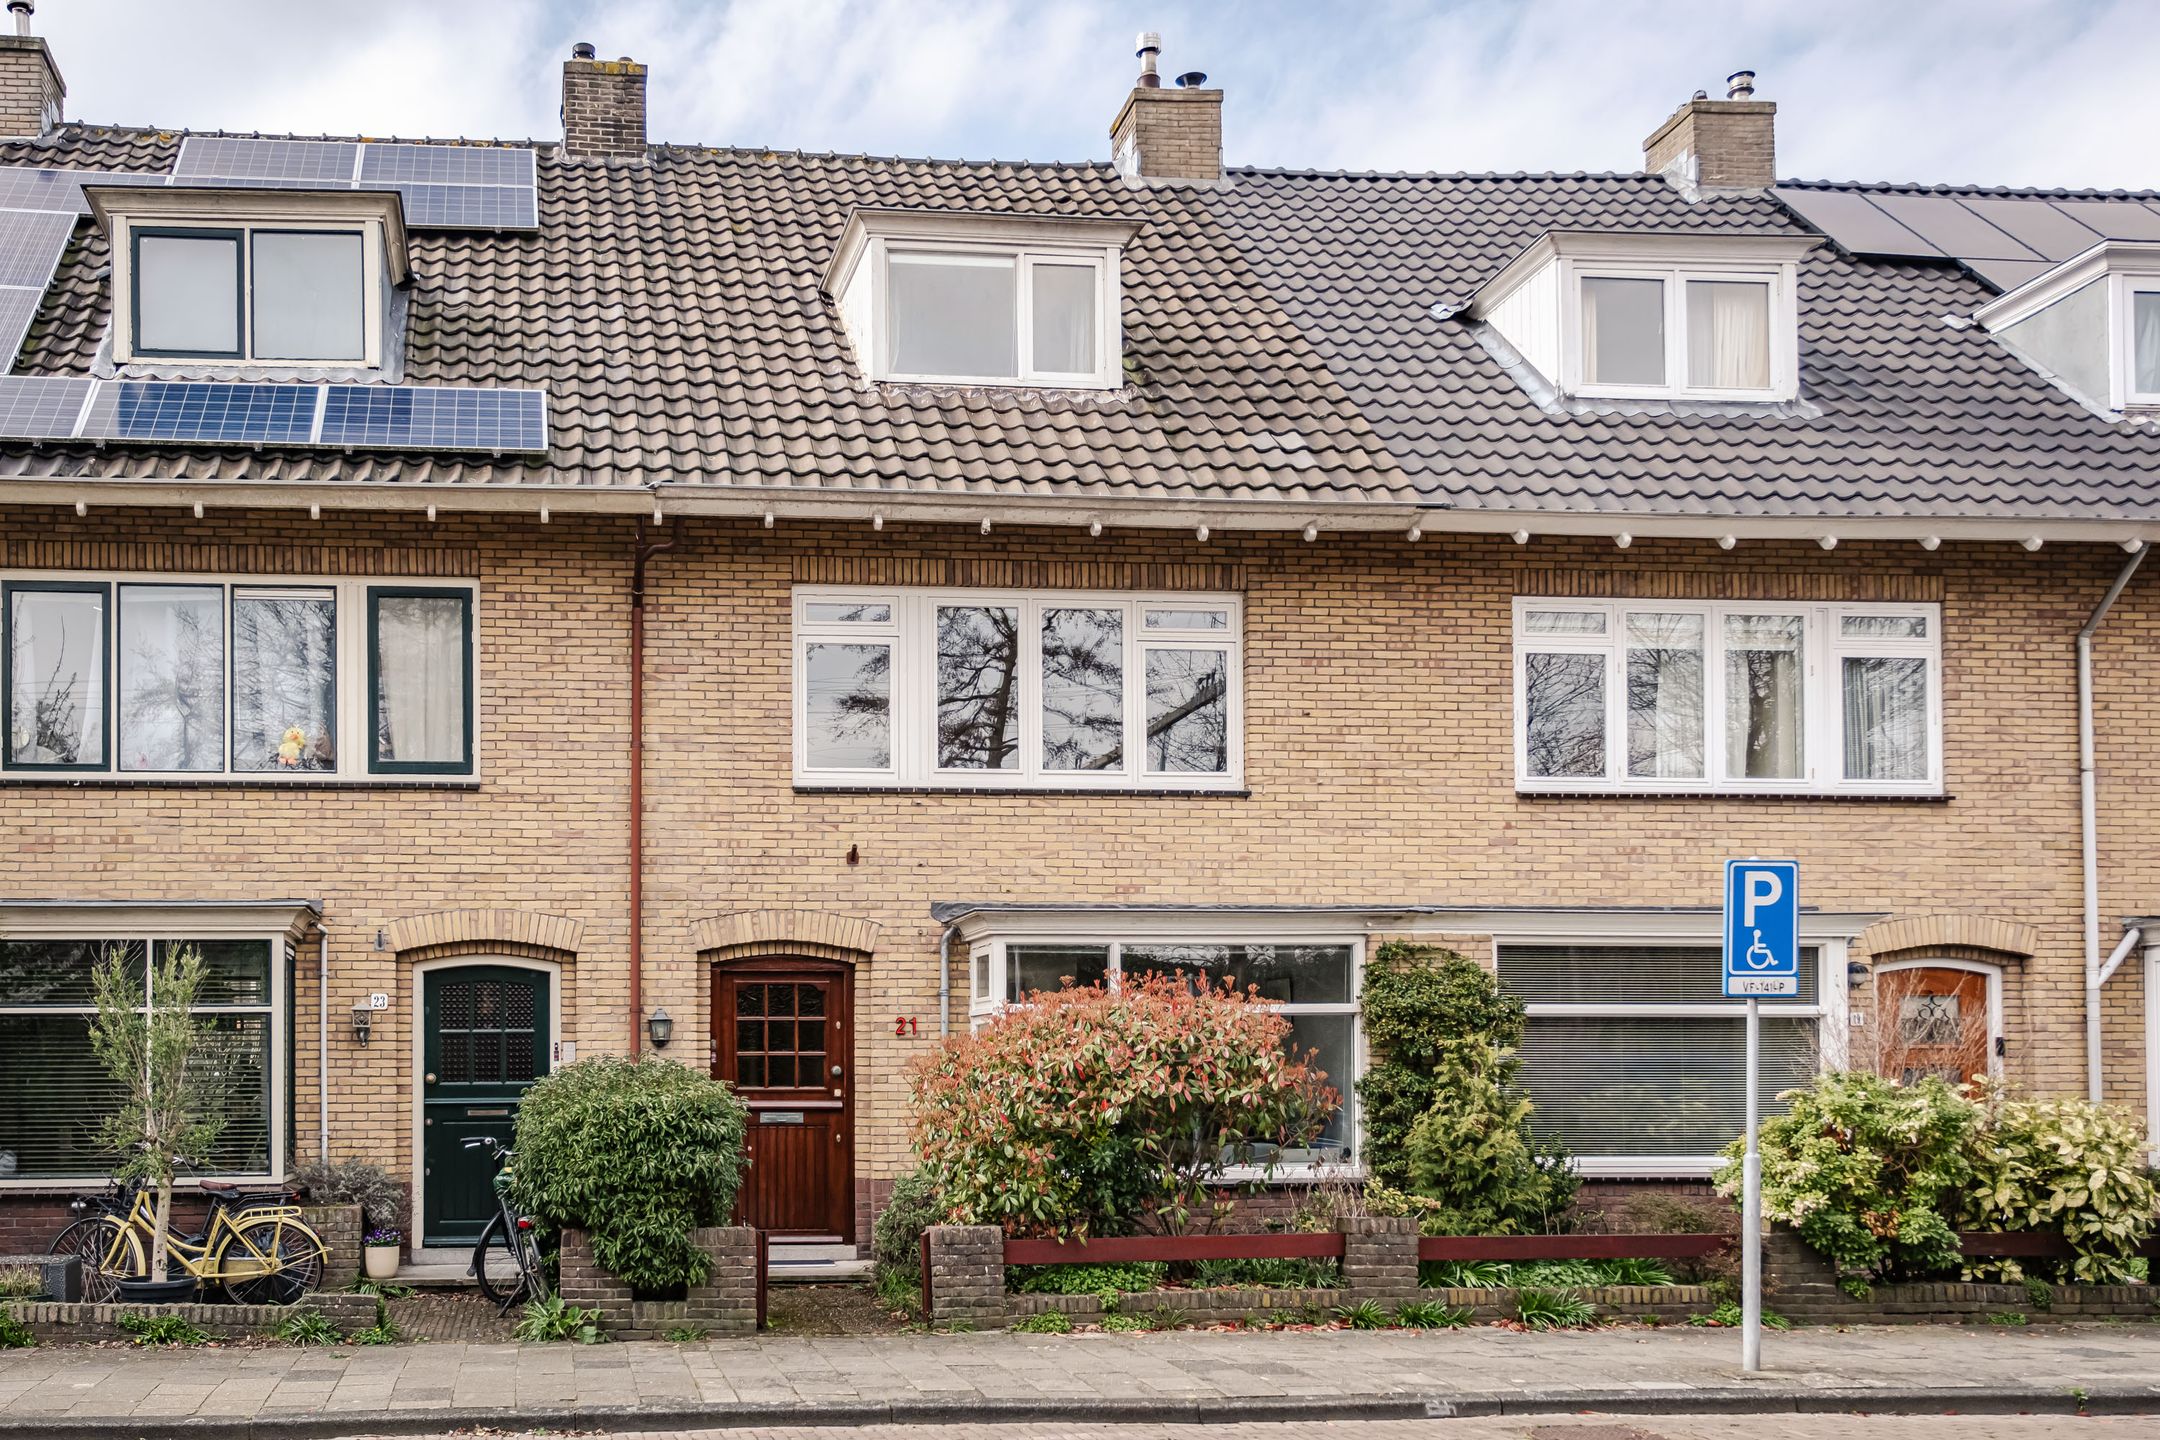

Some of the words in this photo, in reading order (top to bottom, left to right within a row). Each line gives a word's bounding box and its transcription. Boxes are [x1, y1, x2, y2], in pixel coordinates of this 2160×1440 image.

[1744, 871, 1782, 927] P
[374, 996, 386, 1008] 23
[895, 1016, 917, 1036] 21
